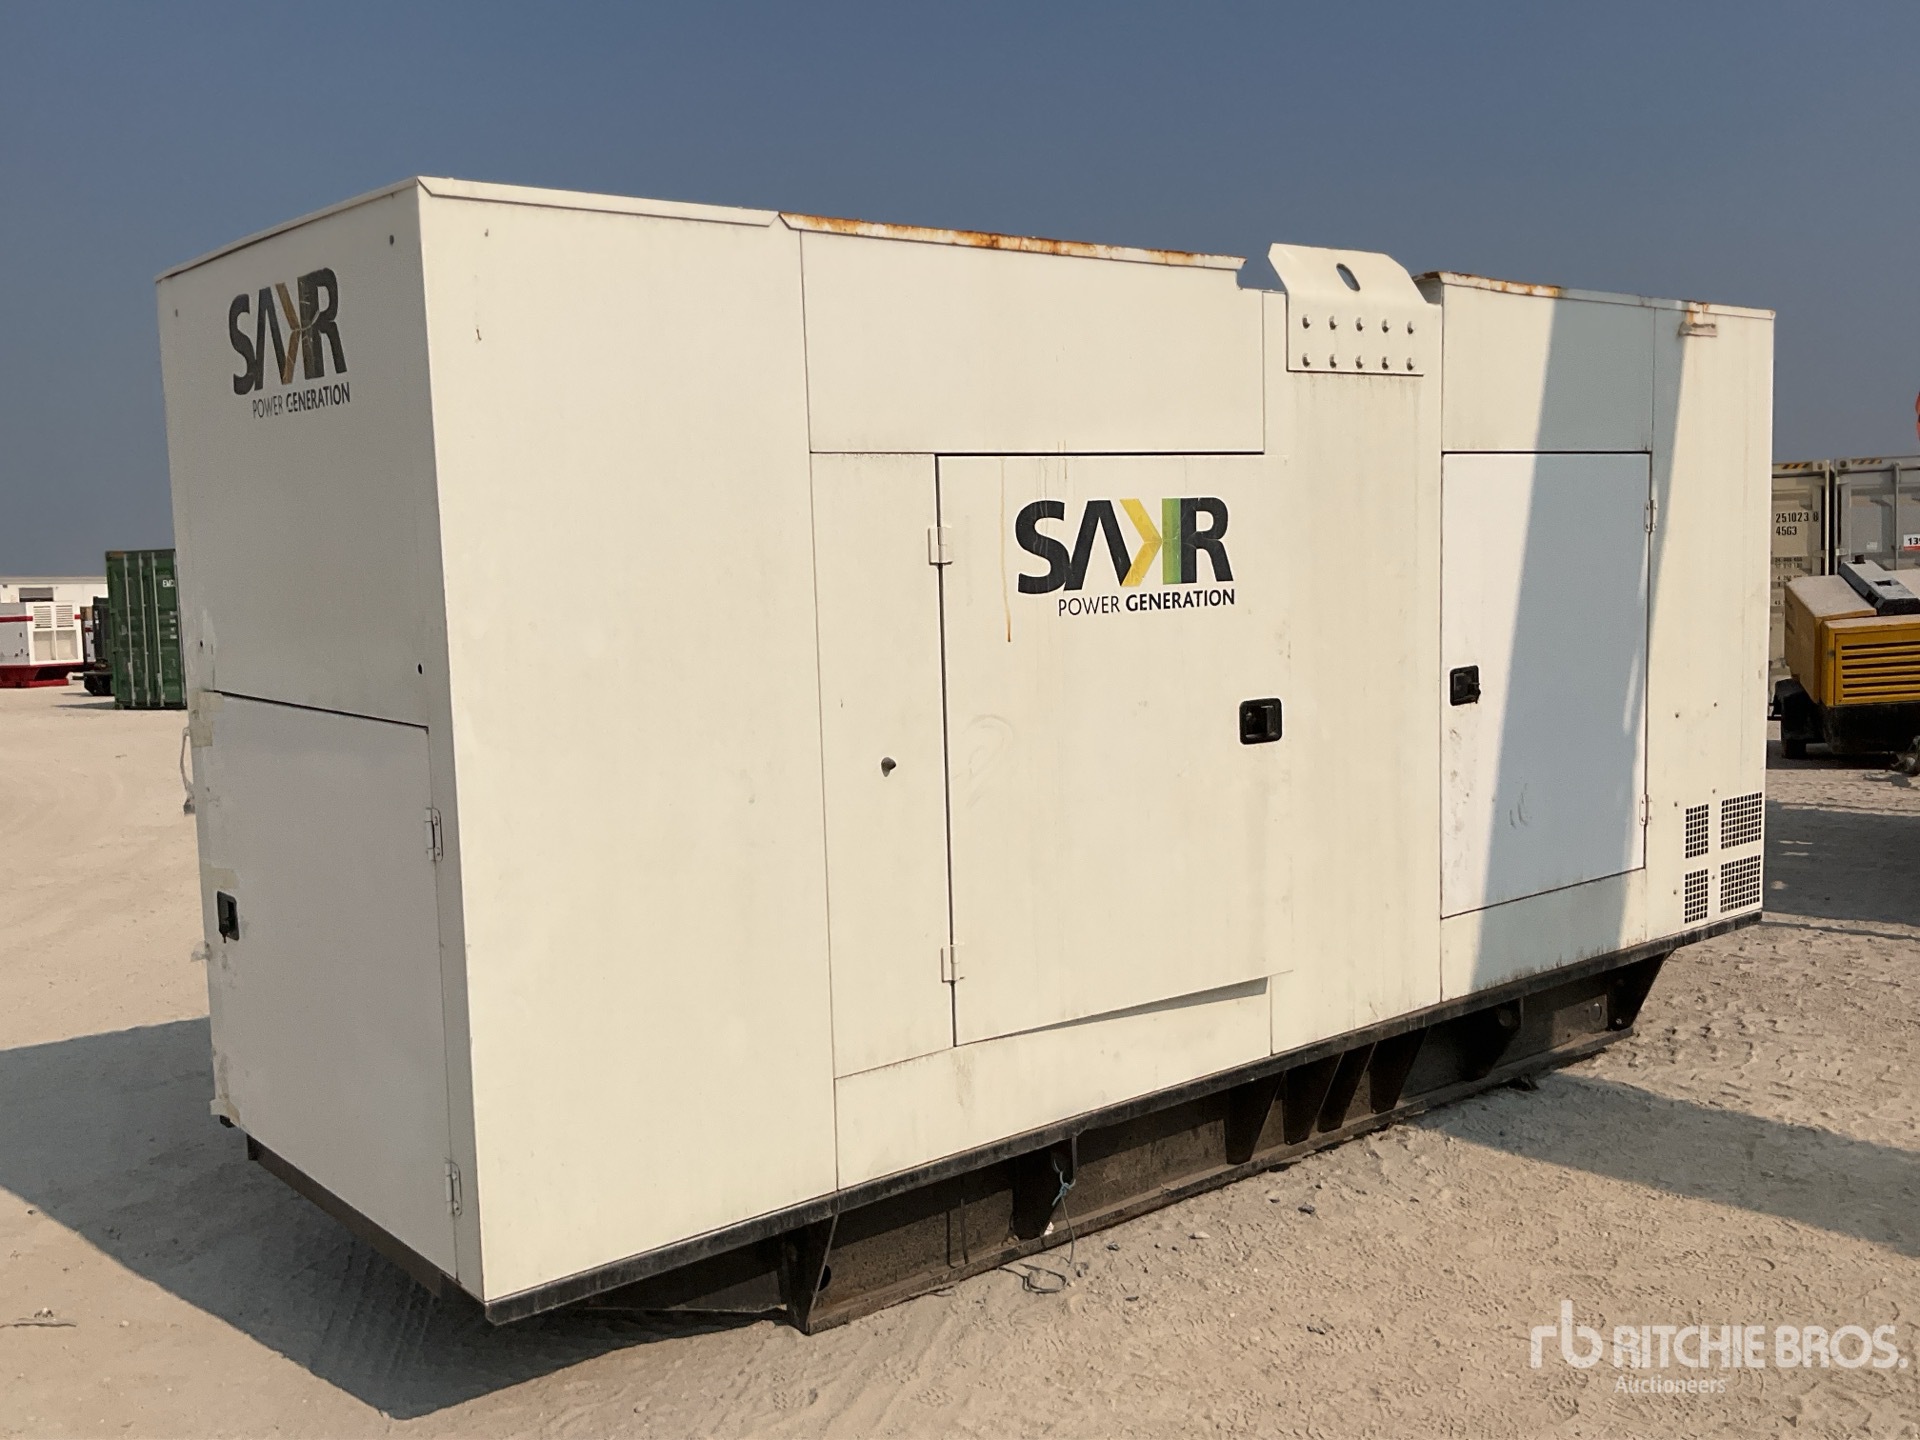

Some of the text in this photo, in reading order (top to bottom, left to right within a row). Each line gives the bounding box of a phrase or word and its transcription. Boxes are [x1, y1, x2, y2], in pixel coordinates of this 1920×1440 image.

[229, 267, 347, 395] SAKR
[253, 382, 350, 418] POWER GENERATION
[1776, 512, 1809, 523] 251023
[1776, 526, 1797, 536] 45G3
[1015, 497, 1234, 594] SAKR
[1058, 589, 1235, 616] POWER GENERATION
